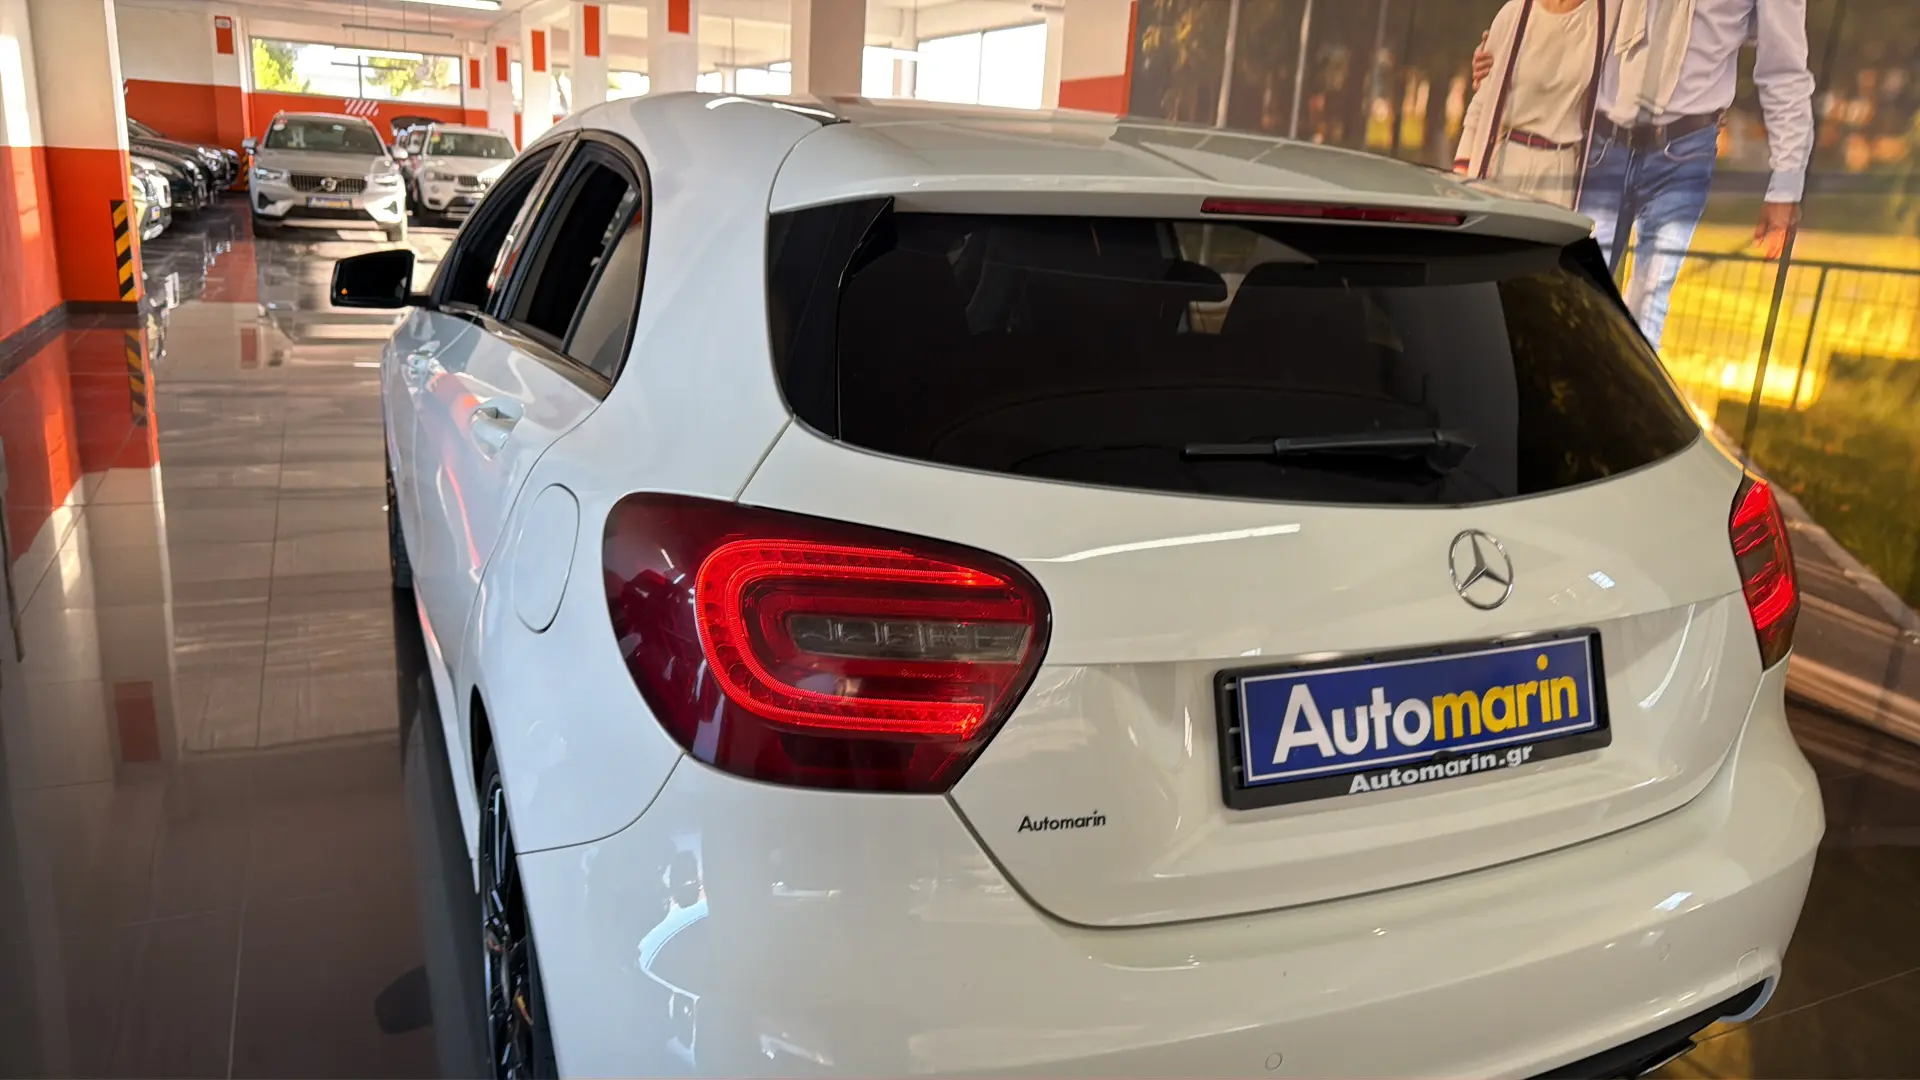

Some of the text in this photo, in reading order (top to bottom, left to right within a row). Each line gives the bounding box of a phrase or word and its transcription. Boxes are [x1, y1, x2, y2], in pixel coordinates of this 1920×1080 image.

[1272, 653, 1579, 764] Automarin
[1348, 744, 1534, 794] Automarin.gr
[1017, 809, 1107, 833] Automarin
